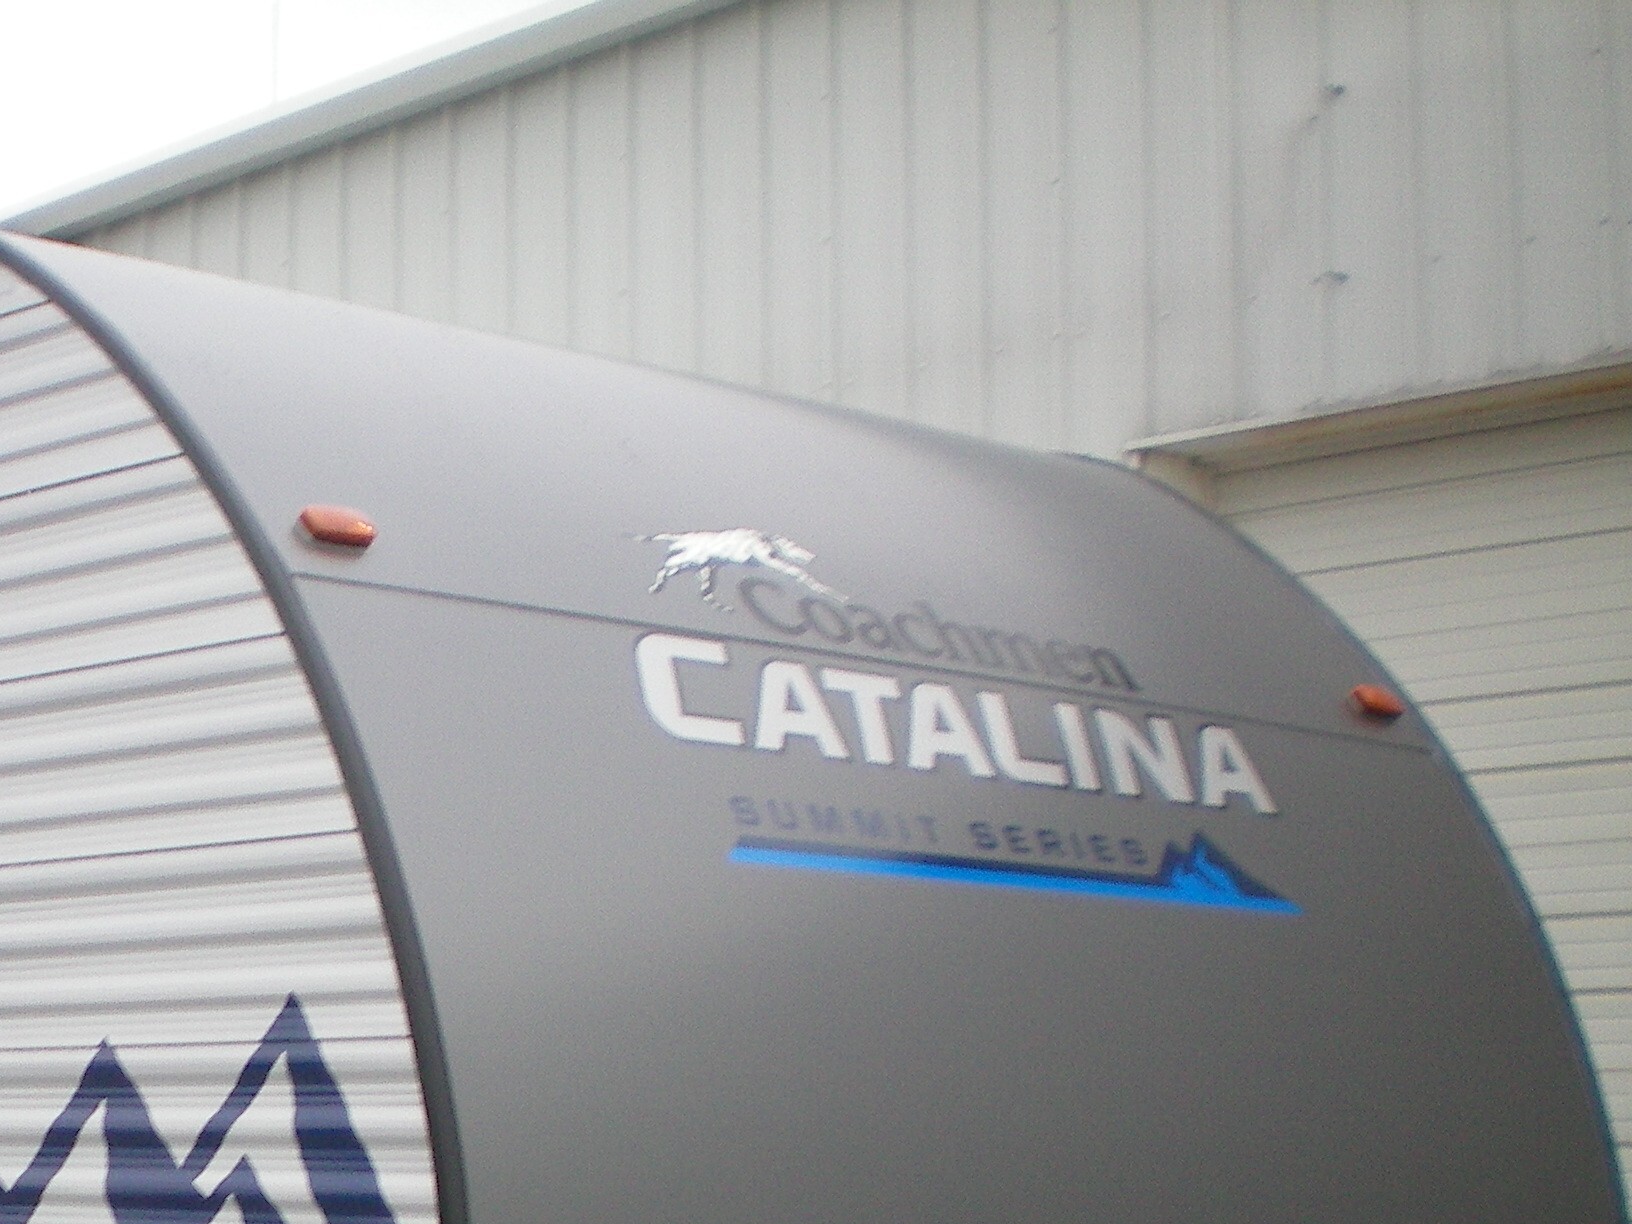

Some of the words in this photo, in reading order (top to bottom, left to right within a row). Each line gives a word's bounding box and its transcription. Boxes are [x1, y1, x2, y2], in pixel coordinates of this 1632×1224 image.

[738, 576, 1139, 690] Coachmen
[634, 632, 1277, 814] CATALINA
[729, 797, 939, 843] SUMMIT
[969, 822, 1149, 866] SERIES
